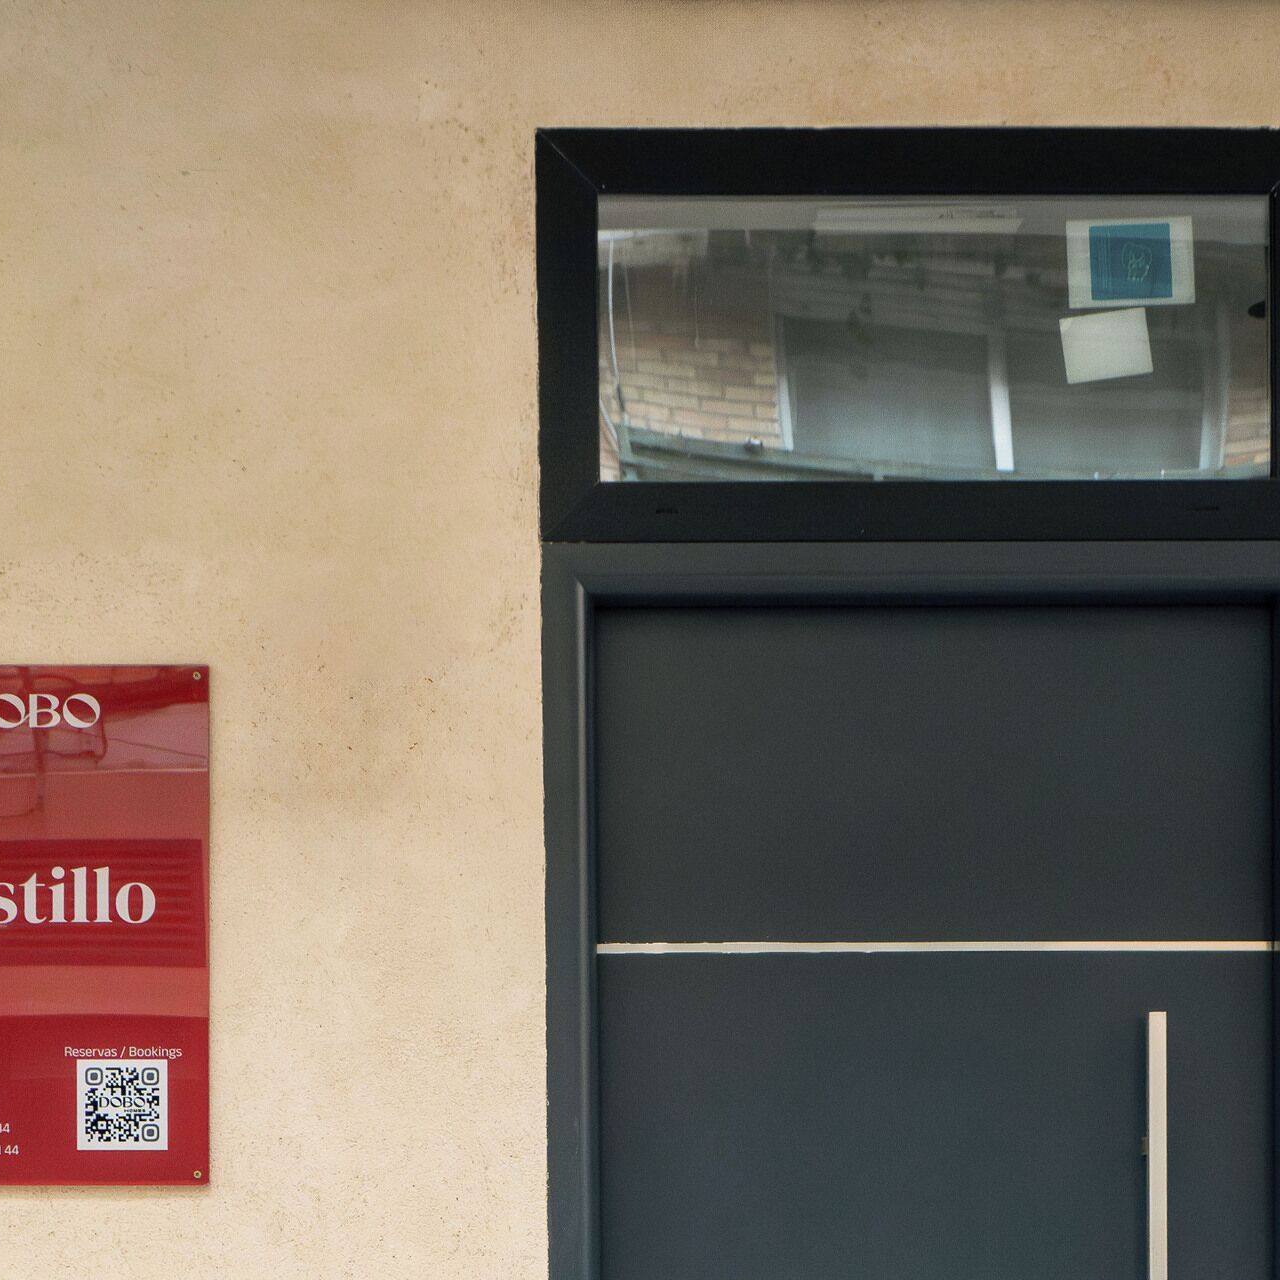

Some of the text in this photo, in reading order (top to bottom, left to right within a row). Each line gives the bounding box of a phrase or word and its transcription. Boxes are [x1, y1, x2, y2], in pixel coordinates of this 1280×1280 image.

[63, 1046, 183, 1060] Reservas / Bookings
[98, 1096, 146, 1109] DOBO
[3, 1144, 20, 1156] 44
